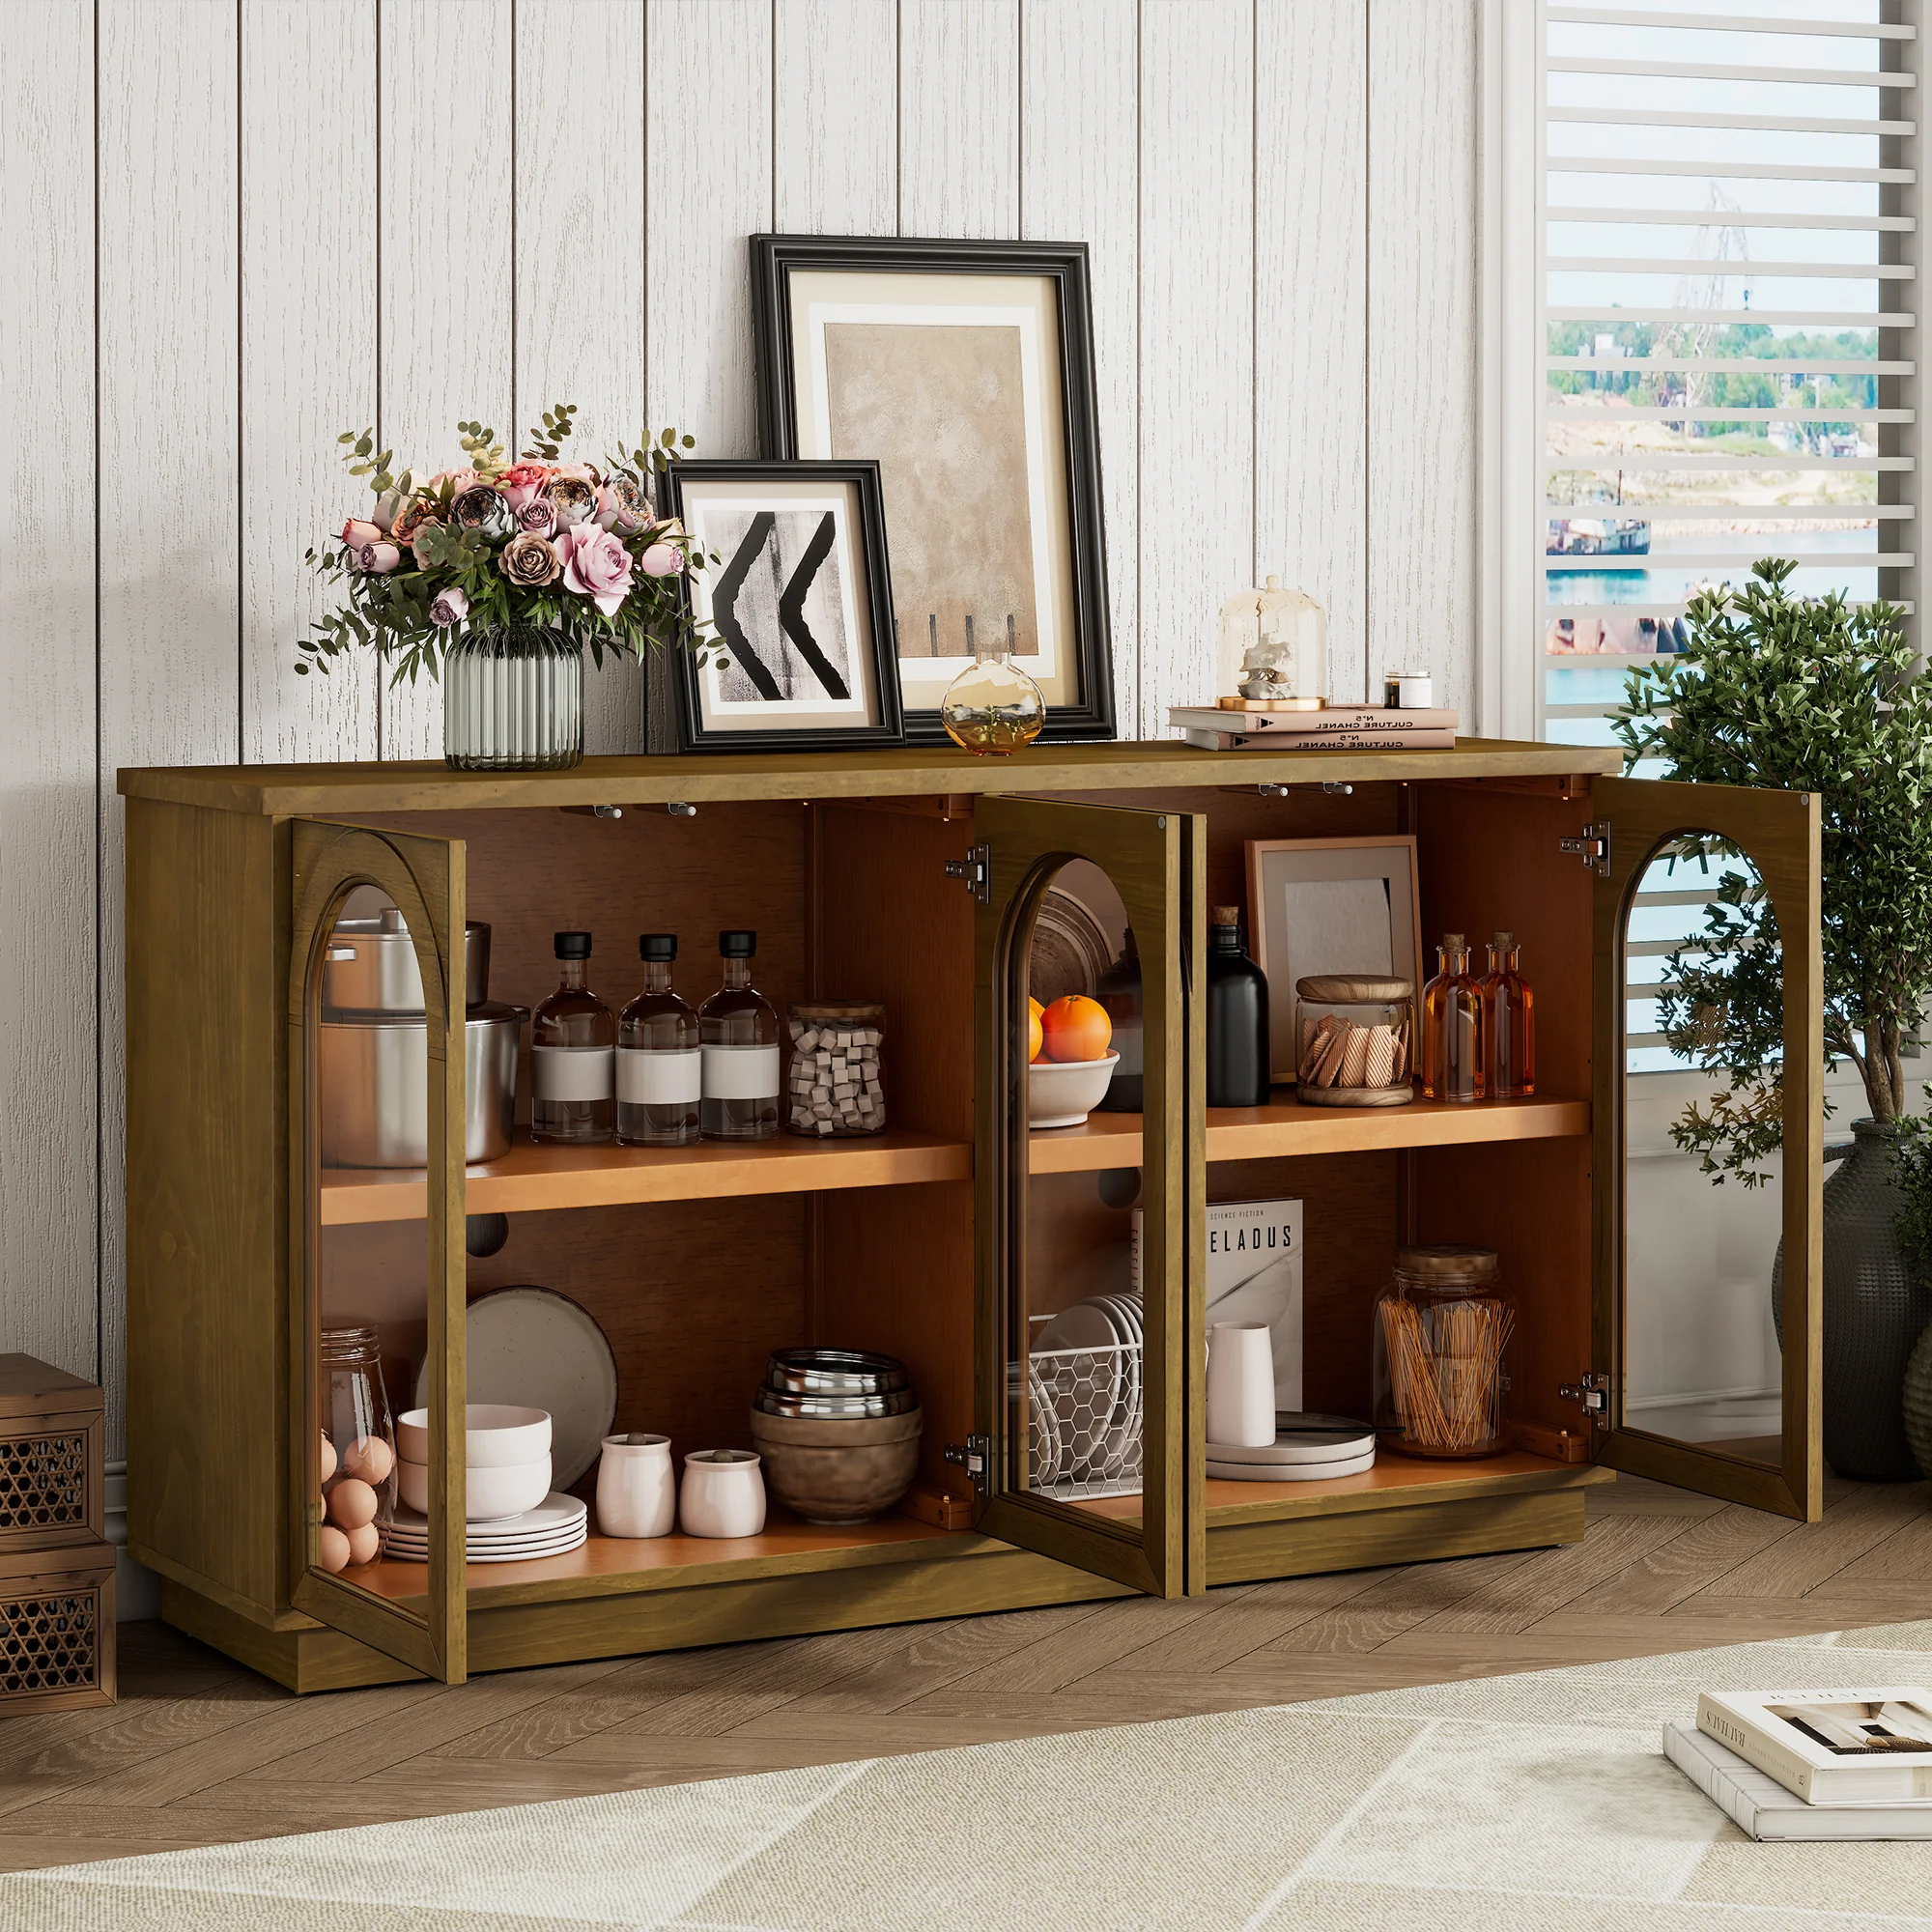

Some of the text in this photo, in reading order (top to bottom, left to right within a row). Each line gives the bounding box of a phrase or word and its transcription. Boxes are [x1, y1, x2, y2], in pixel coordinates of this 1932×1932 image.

[1209, 1209, 1264, 1221] SCIENCE FICTION
[1210, 1225, 1292, 1253] ELADUS
[1706, 1711, 1746, 1747] BAUHAUS
